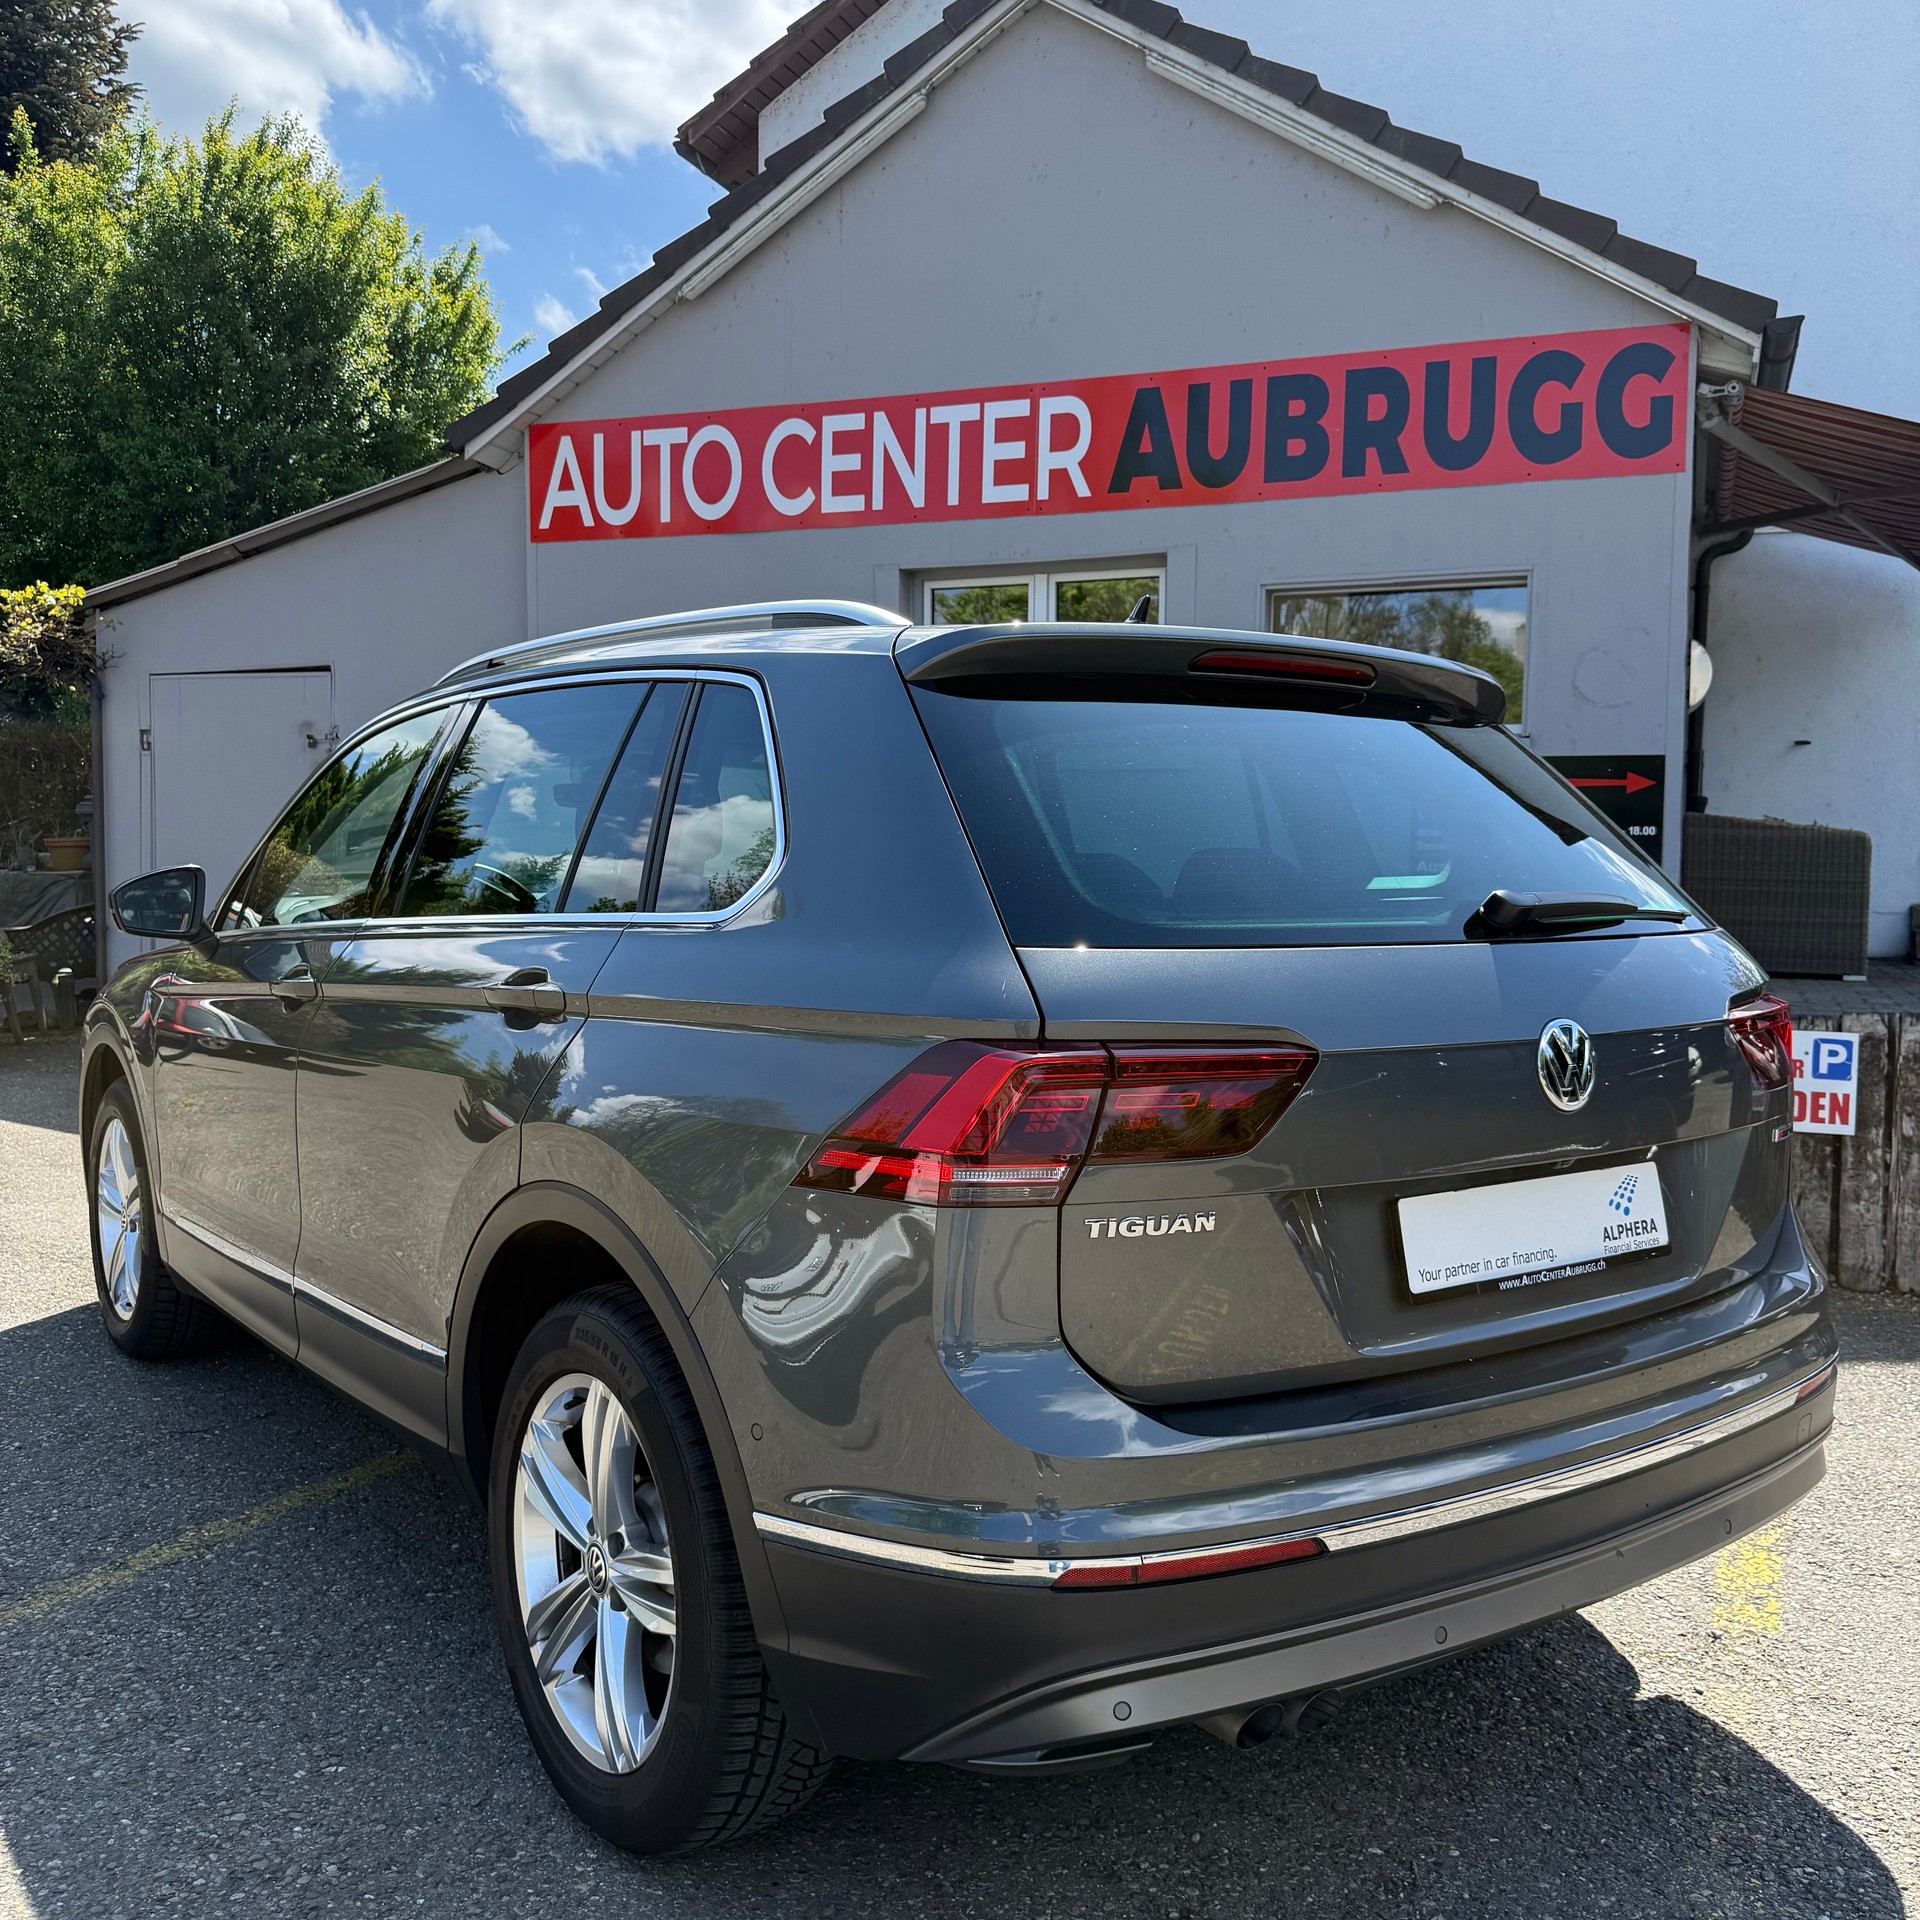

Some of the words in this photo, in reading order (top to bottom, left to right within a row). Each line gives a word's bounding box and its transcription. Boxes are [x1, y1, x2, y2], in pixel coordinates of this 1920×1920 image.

[538, 424, 743, 530] AUTO
[761, 395, 1093, 516] CENTER
[1107, 341, 1677, 493] AUBRUGG
[1627, 825, 1657, 837] 18.00
[1818, 1042, 1848, 1075] P
[1084, 1211, 1216, 1239] TIGUAN
[1603, 1217, 1659, 1243] ALPHERA
[1603, 1240, 1632, 1256] Financial
[1632, 1237, 1660, 1250] Services
[1418, 1268, 1442, 1283] Your
[1445, 1261, 1481, 1282] partner
[1483, 1258, 1493, 1271] in
[1495, 1256, 1510, 1269] car
[1512, 1247, 1558, 1265] financing.
